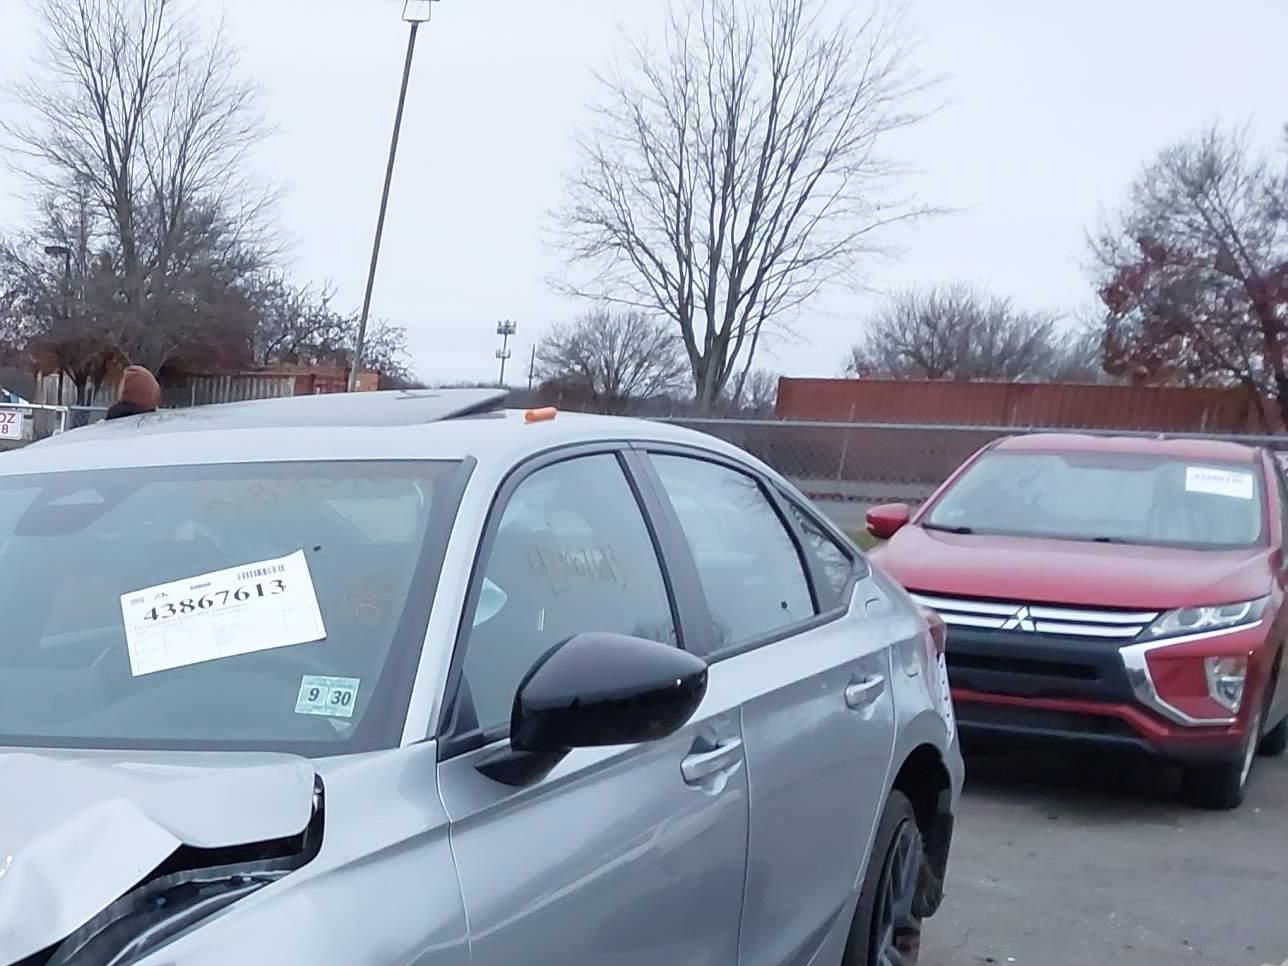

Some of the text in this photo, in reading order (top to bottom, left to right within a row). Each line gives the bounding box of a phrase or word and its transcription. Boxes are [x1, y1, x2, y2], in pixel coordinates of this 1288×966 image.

[2, 424, 9, 434] 8
[143, 579, 287, 620] 43867613
[308, 687, 352, 706] 9 30
